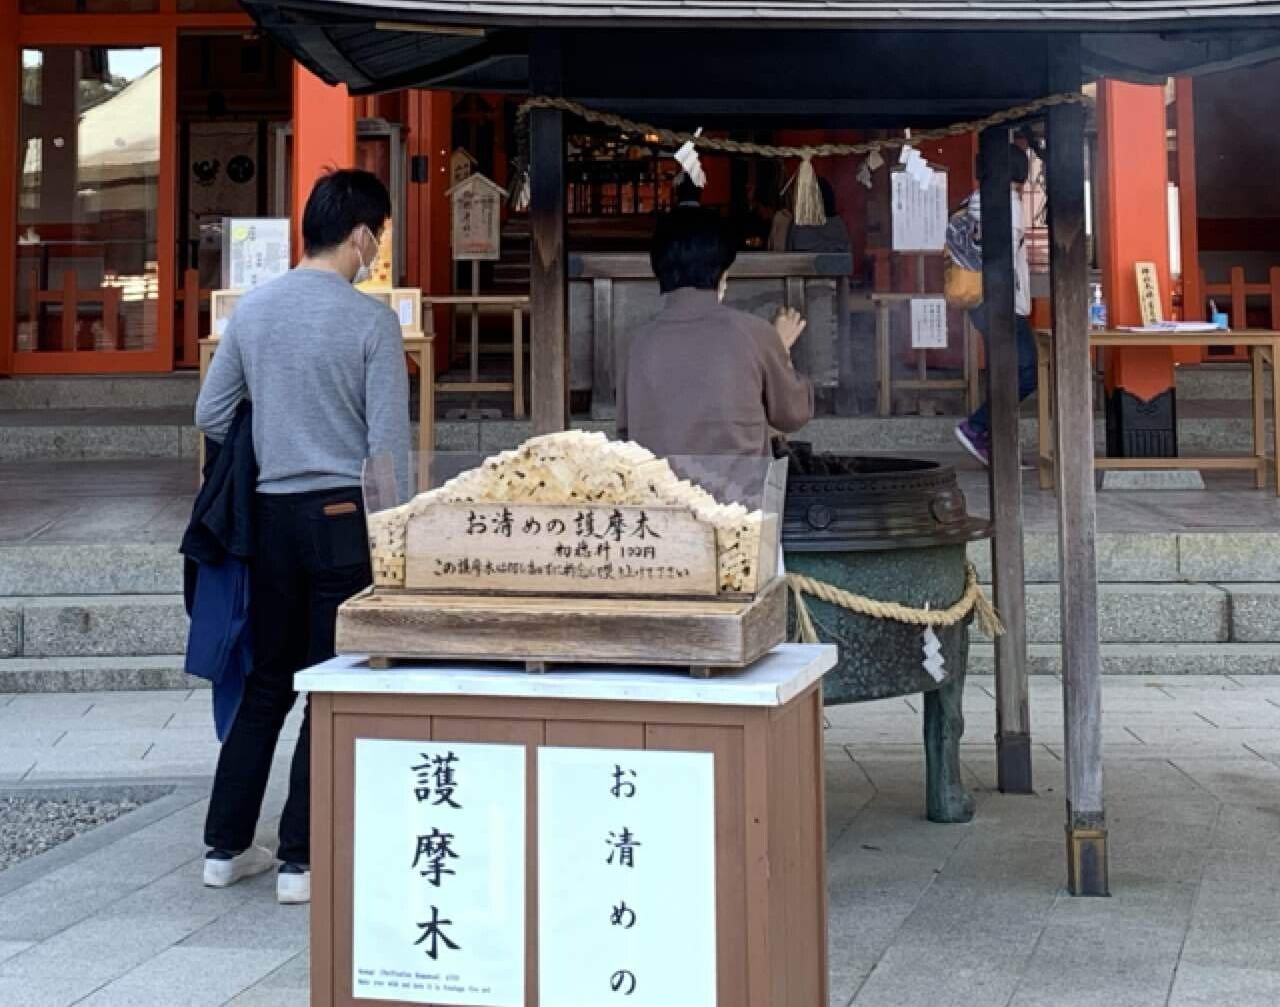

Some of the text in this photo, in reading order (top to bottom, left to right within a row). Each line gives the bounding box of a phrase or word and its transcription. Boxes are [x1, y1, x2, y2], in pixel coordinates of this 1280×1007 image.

[466, 507, 662, 542] お清めの護摩木
[410, 751, 463, 961] 護摩木
[605, 764, 642, 996] お清めの
